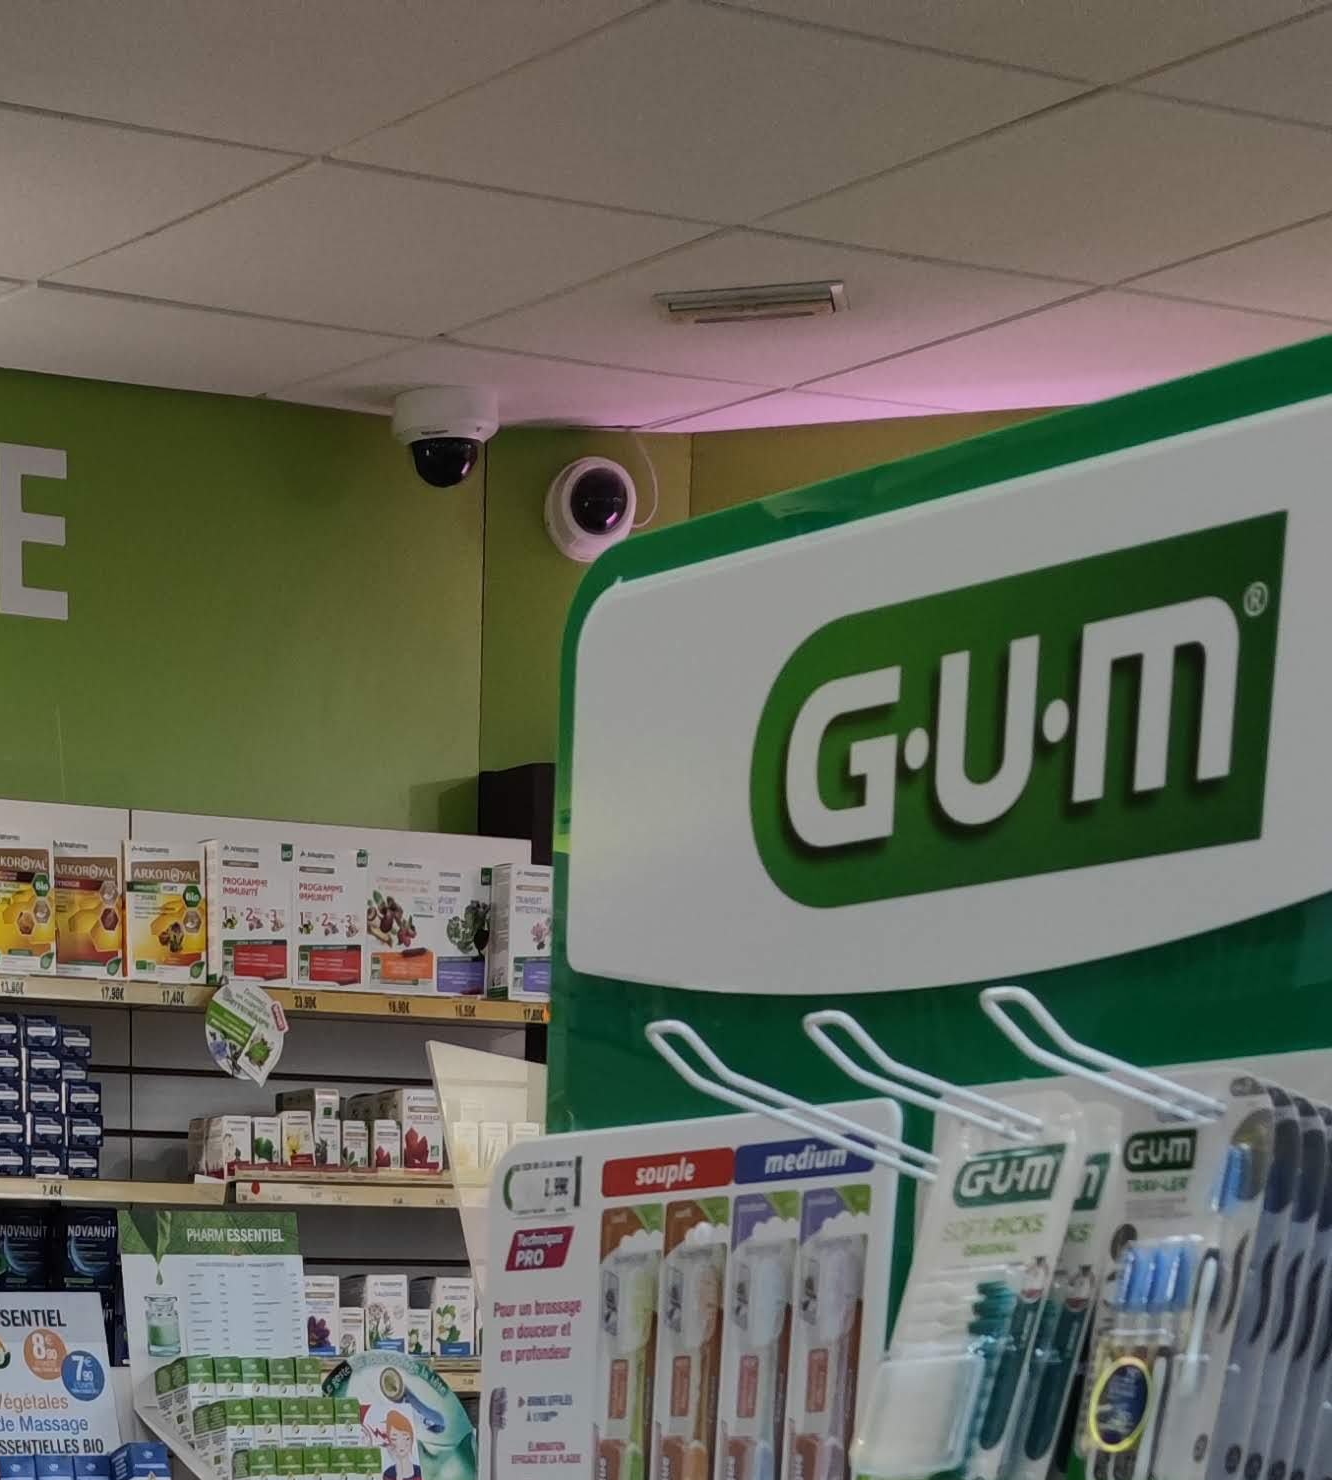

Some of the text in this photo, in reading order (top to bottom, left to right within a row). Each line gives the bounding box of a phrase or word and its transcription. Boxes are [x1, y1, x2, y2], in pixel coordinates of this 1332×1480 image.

[133, 867, 198, 882] ARKOROYAL
[635, 1145, 849, 1190] souple medium
[187, 1228, 285, 1243] PHARM'ESSENTIEL
[517, 1231, 564, 1249] Technique
[515, 1251, 545, 1269] PRO
[493, 1299, 582, 1319] Pour un brossage
[501, 1321, 572, 1340] en douceur et
[500, 1343, 572, 1363] en profondeur
[20, 1416, 88, 1437] Massage
[83, 1438, 104, 1454] BIO
